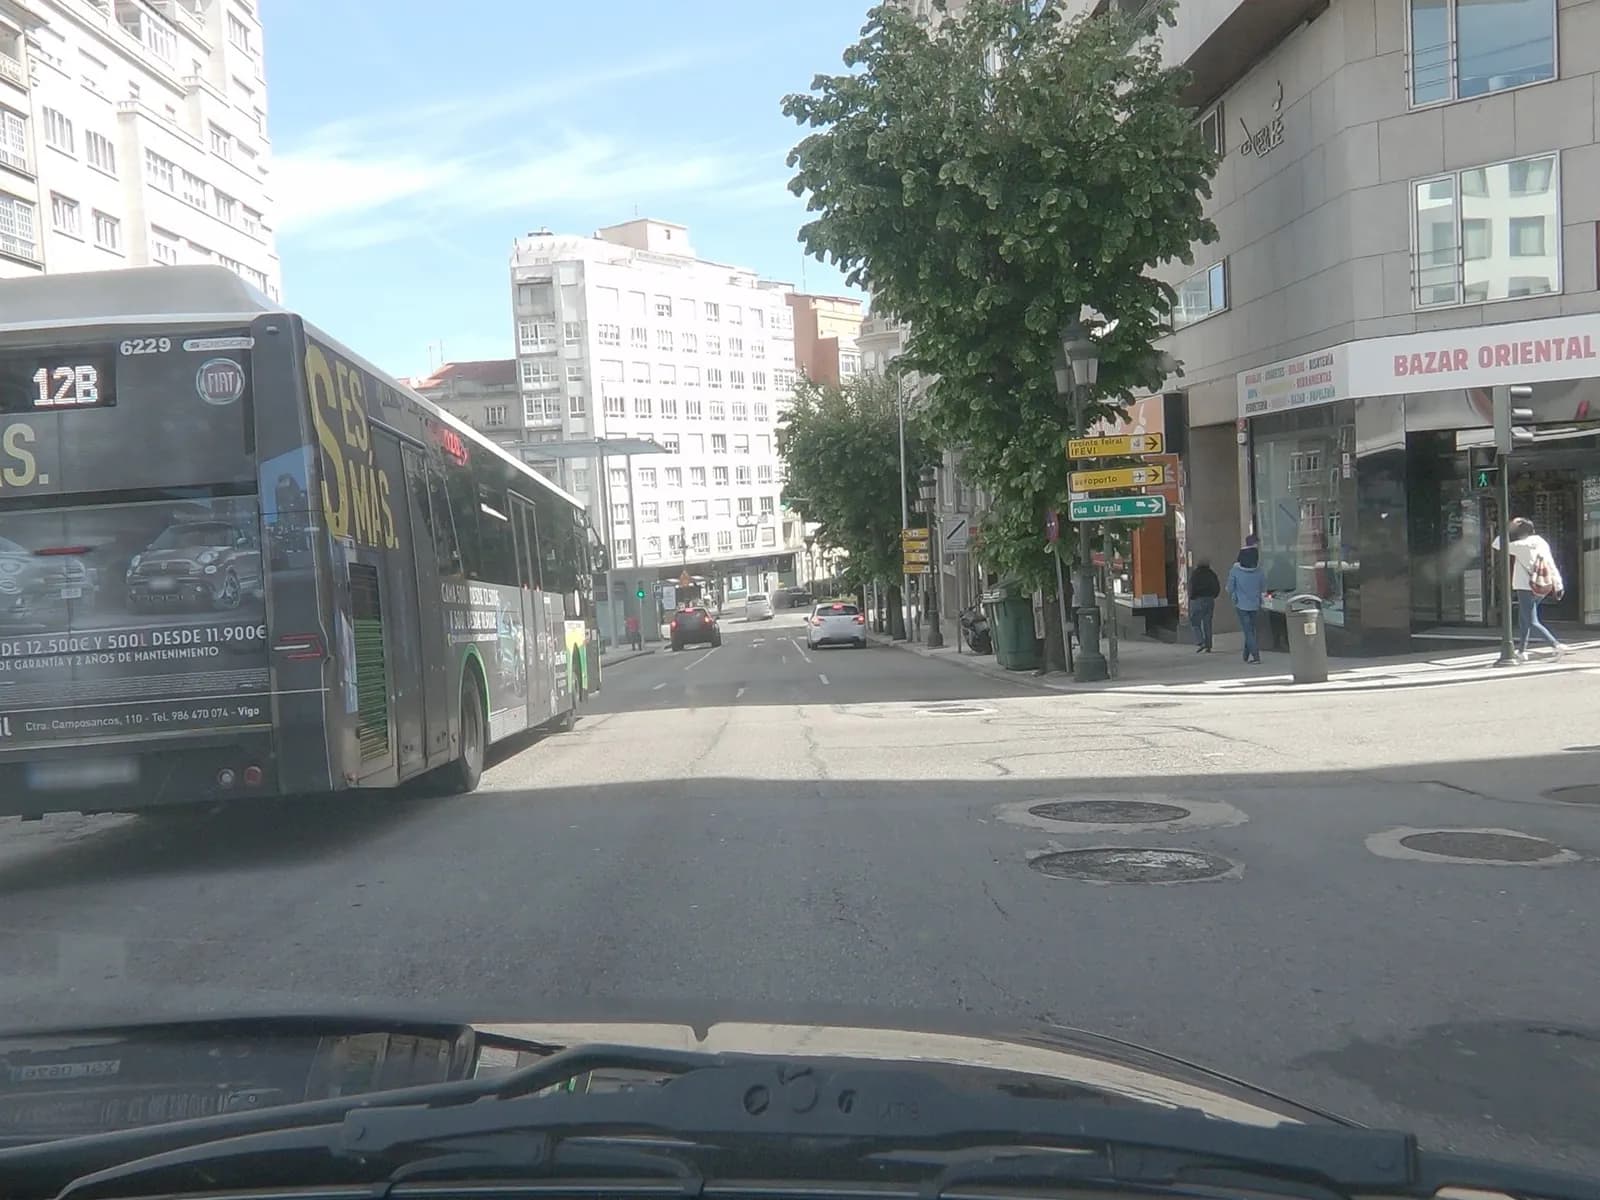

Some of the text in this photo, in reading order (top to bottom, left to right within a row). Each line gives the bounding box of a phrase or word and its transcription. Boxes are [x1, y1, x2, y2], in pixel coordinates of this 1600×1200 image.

[120, 338, 171, 356] 6229
[1393, 335, 1597, 377] BAZAR ORIENTAL
[33, 365, 98, 405] 12B
[207, 371, 236, 394] FIAT
[1071, 447, 1096, 456] IFEVI
[26, 637, 91, 654] 12.500€
[94, 637, 101, 649] Y
[108, 632, 147, 649] 500L
[152, 629, 201, 646] DESDE
[205, 625, 267, 642] 11.900€
[15, 655, 64, 671] GARANTÍA
[66, 657, 72, 666] Y
[76, 657, 82, 666] 2
[84, 653, 115, 665] AÑOS
[118, 651, 132, 662] DE
[134, 646, 219, 662] MANTENIMIENTO
[25, 721, 50, 732] Ctra.
[52, 716, 123, 731] Camposancos,
[125, 714, 142, 725] 110
[172, 710, 189, 721] 986
[191, 709, 209, 720] 470
[211, 708, 228, 719] 074
[238, 706, 260, 718] Vigo
